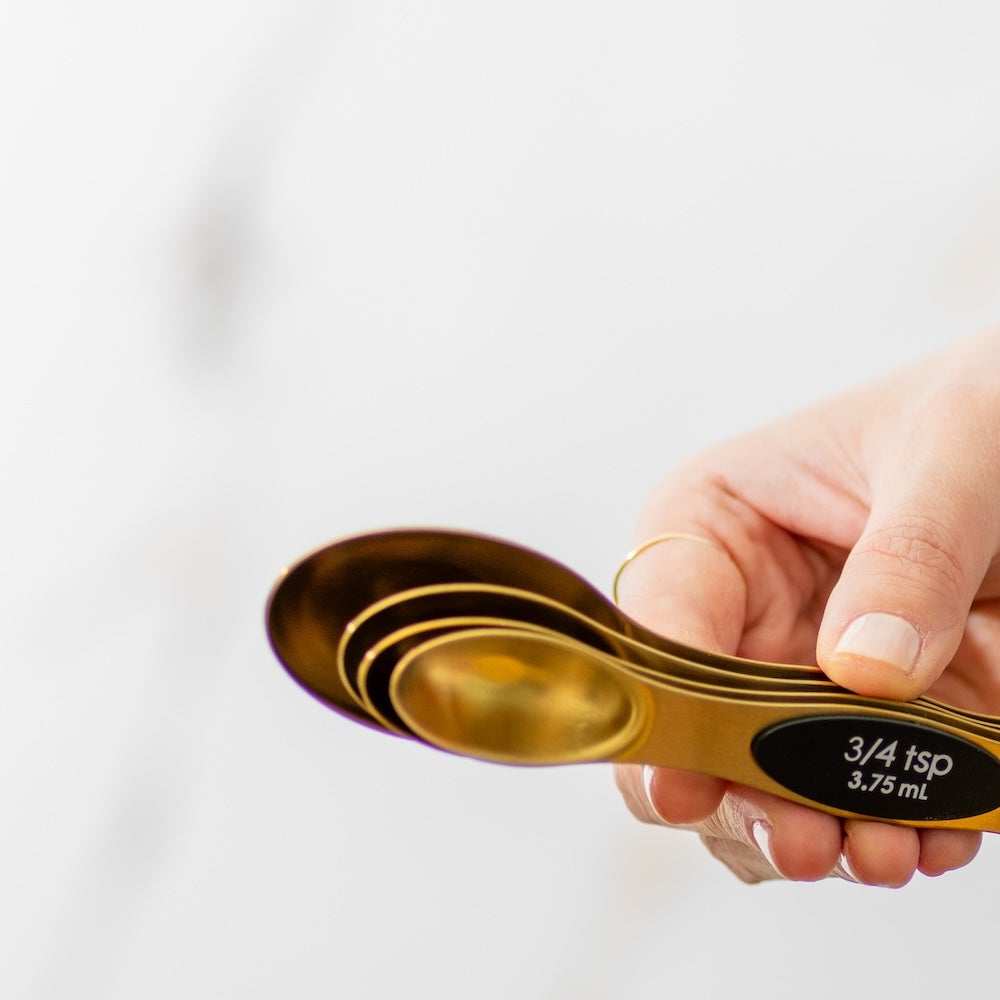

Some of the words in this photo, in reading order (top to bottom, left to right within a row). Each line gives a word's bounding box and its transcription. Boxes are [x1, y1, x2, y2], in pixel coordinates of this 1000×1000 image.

[843, 735, 899, 768] 3/4
[903, 744, 954, 781] tsp
[847, 770, 897, 795] 3.75
[897, 782, 928, 801] mL
